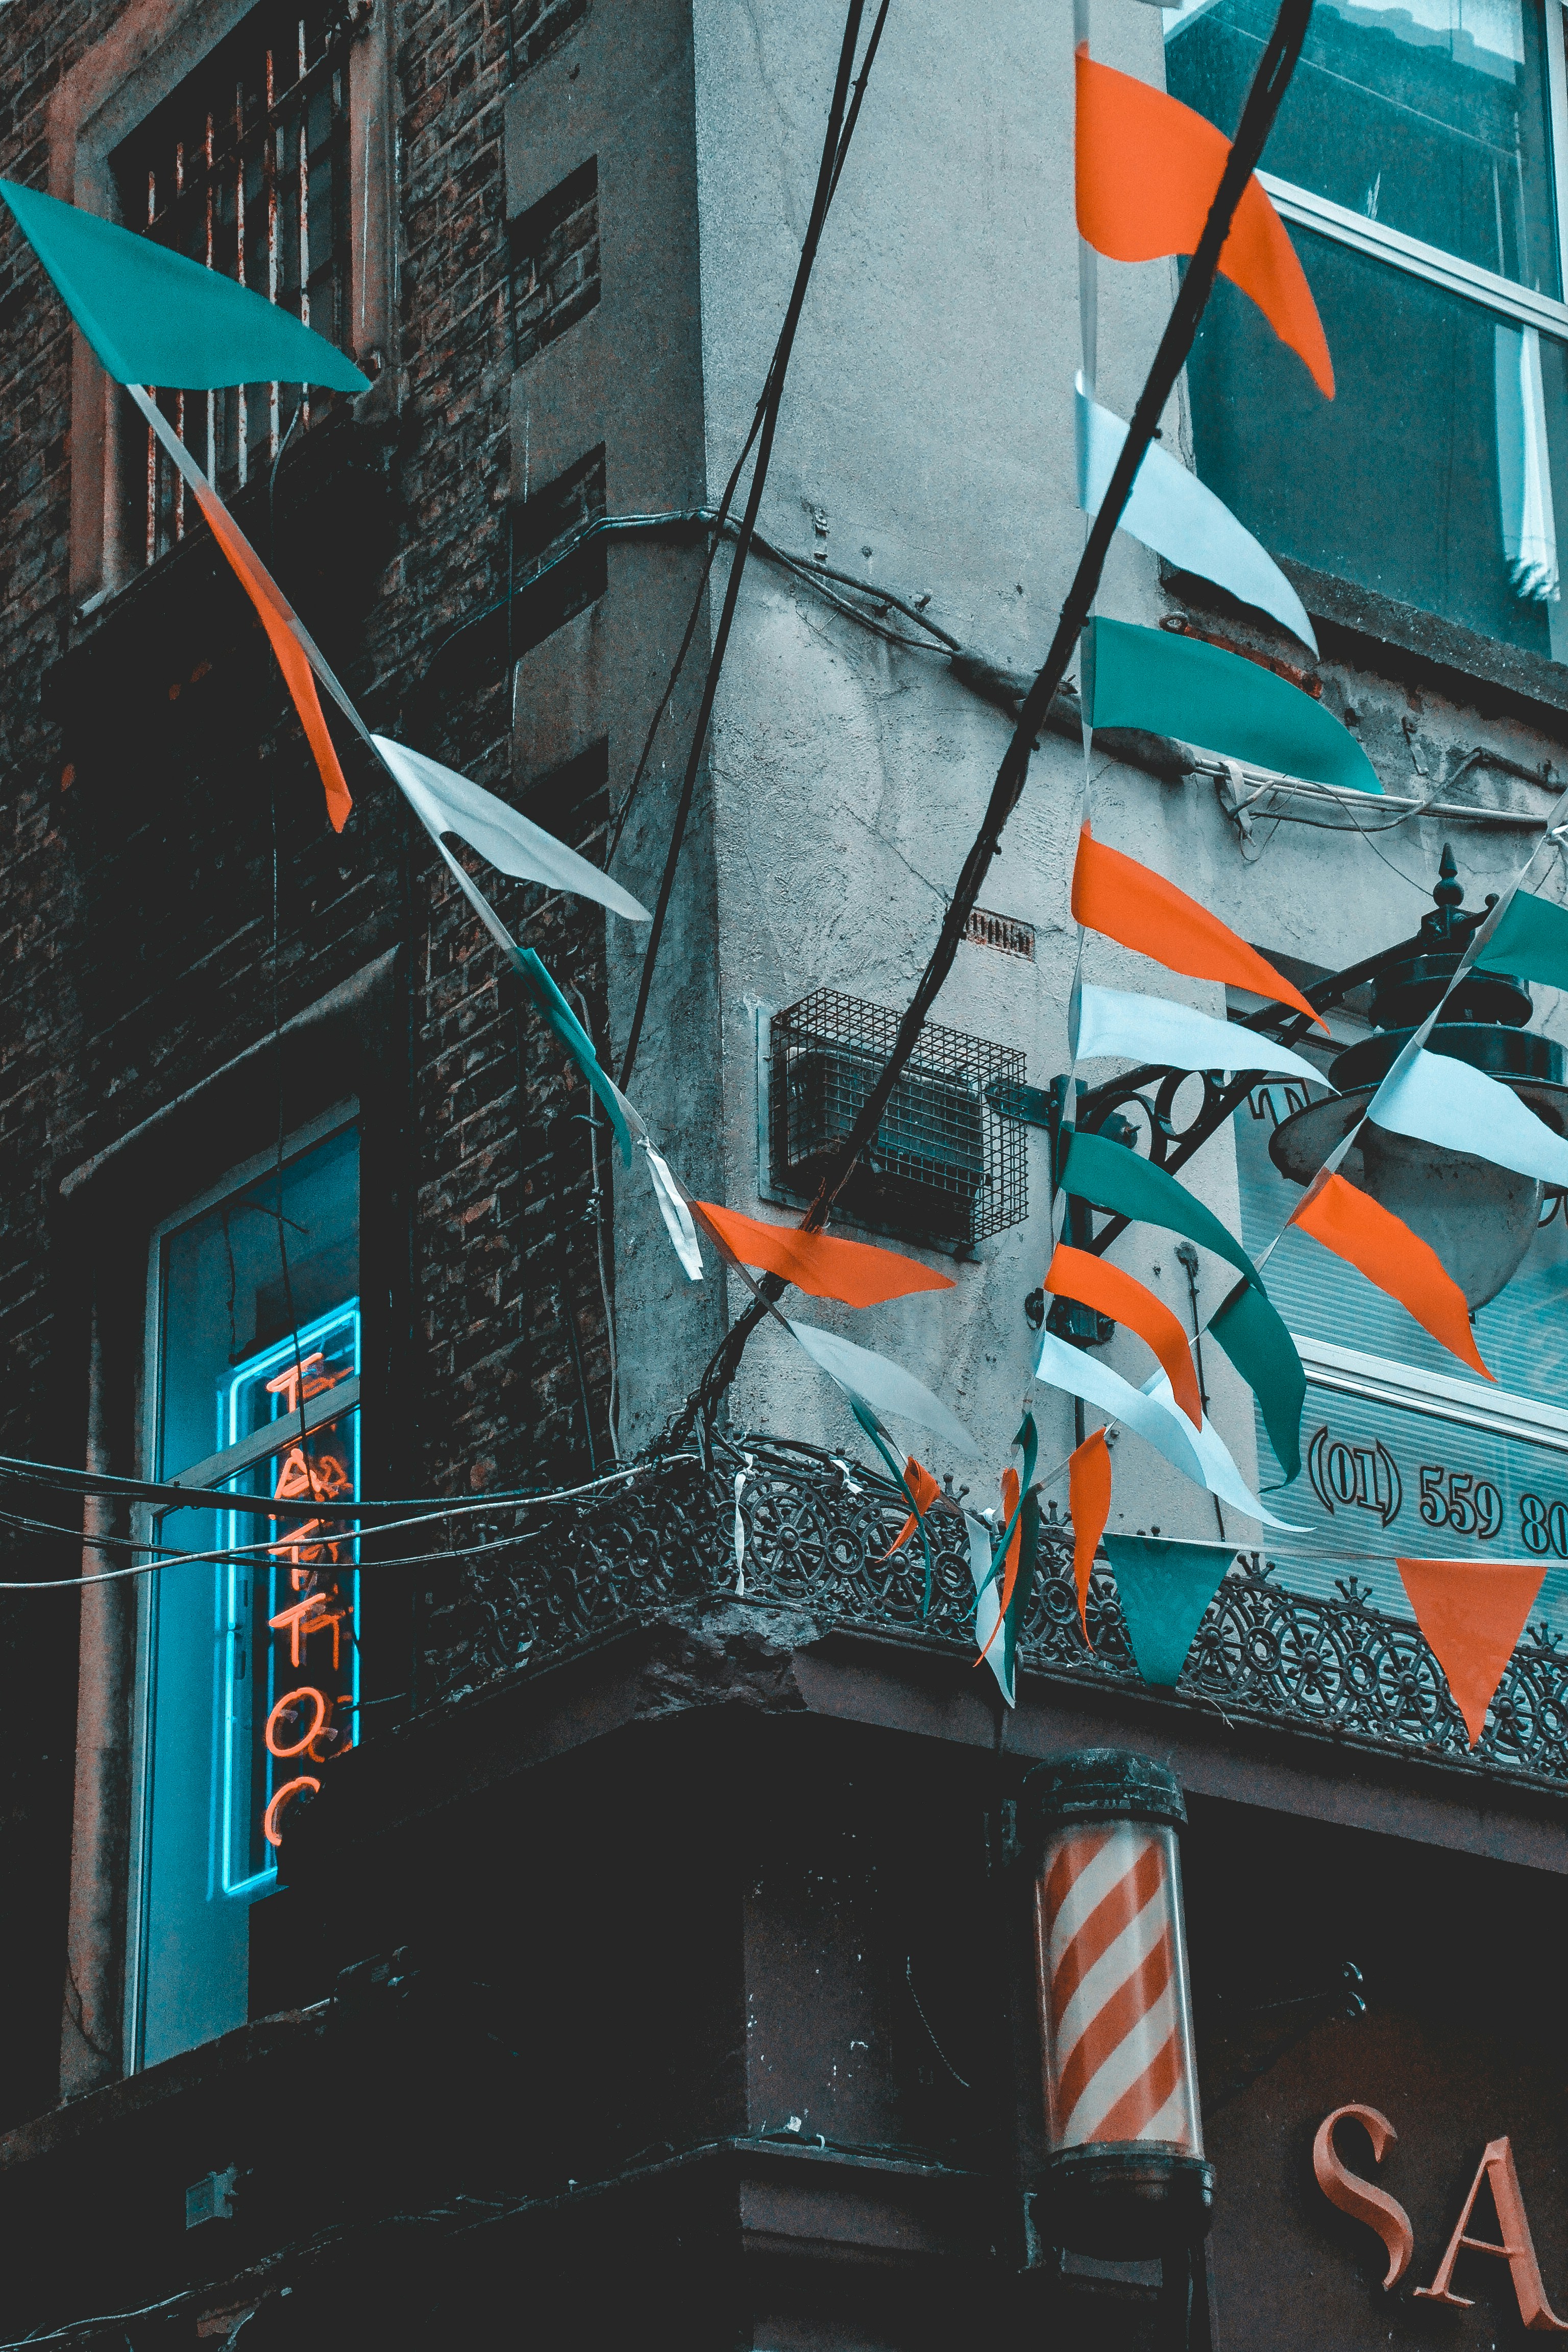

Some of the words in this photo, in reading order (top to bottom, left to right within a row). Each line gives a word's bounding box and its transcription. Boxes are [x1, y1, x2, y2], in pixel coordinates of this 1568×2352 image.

[1308, 1426, 1402, 1527] (01)
[1419, 1466, 1503, 1539] 559
[1313, 2103, 1568, 2331] SA
